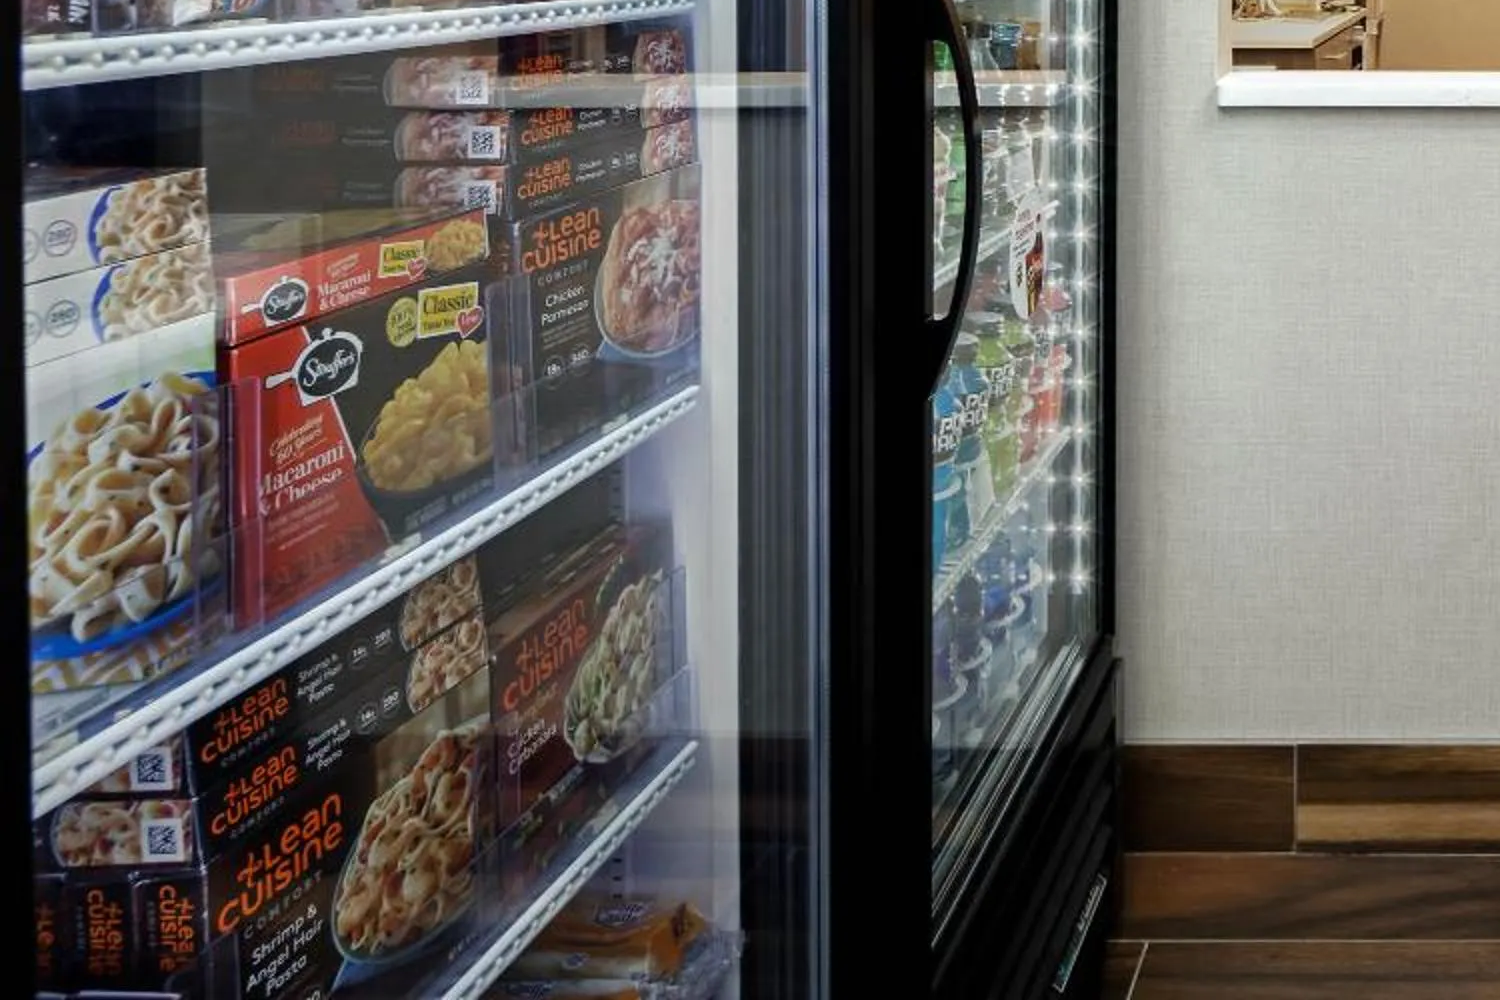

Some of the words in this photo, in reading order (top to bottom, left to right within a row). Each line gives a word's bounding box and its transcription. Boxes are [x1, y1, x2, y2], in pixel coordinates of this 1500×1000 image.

[317, 270, 372, 298] Macaroni
[423, 291, 476, 316] Classic
[545, 285, 585, 308] Chicken
[257, 440, 344, 497] Macaroni
[252, 916, 304, 966] Shrimp
[246, 945, 291, 993] Angel
[265, 955, 308, 998] Pasta
